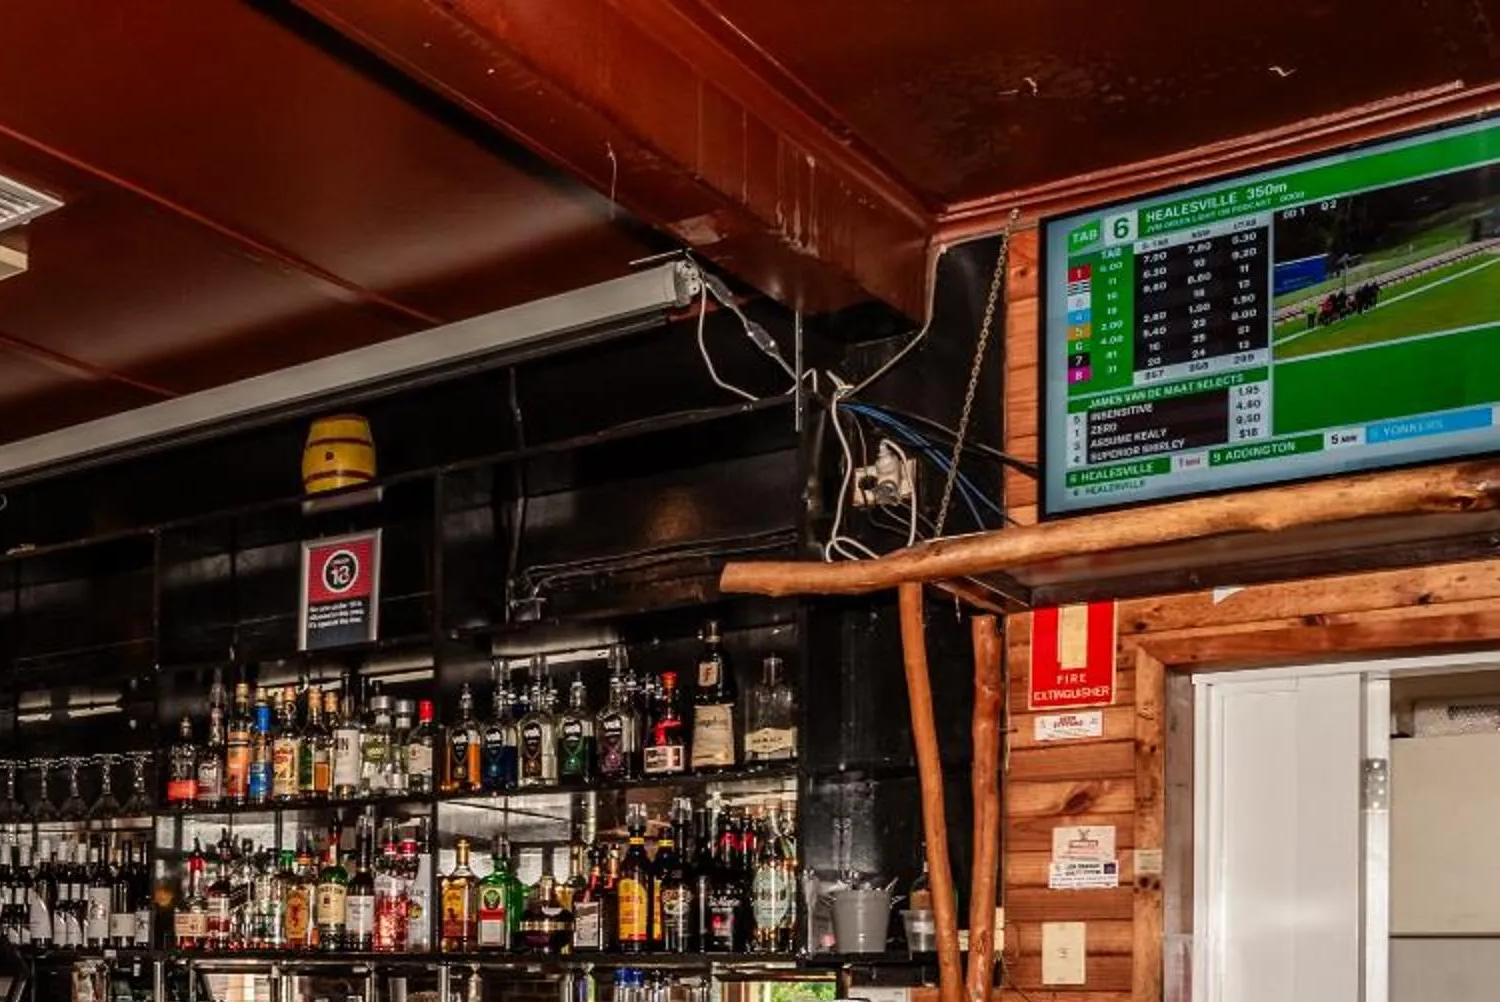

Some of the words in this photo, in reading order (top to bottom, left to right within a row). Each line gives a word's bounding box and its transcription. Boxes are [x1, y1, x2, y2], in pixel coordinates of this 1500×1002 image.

[1145, 191, 1237, 223] HEALESVILLE
[1246, 183, 1287, 200] 350m
[1113, 217, 1129, 239] 6
[1148, 388, 1162, 400] DE
[1196, 373, 1245, 391] SELECTS
[1090, 402, 1153, 422] INSENSITIVE
[1091, 423, 1117, 435] ZERO
[1081, 461, 1154, 481] HEALESVILLE
[1225, 440, 1296, 461] ADDINGTON
[1056, 673, 1087, 685] FIRE
[1033, 685, 1109, 701] EXTINGUISHER
